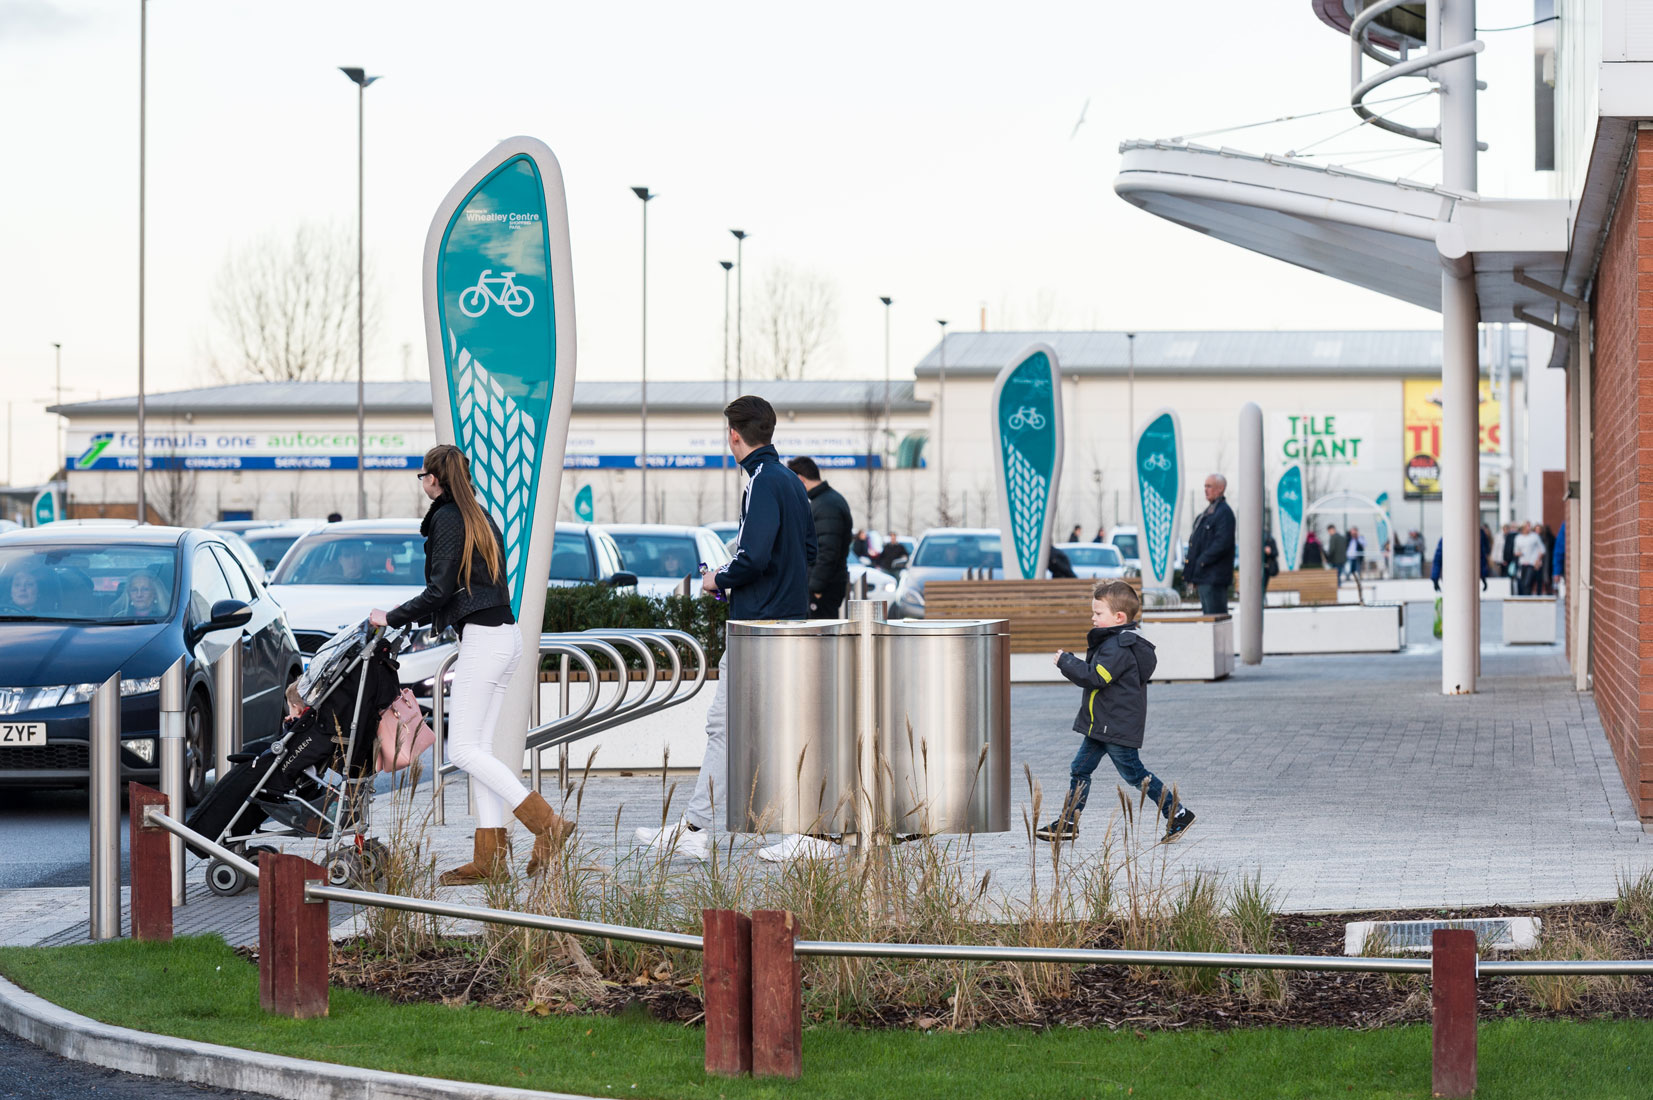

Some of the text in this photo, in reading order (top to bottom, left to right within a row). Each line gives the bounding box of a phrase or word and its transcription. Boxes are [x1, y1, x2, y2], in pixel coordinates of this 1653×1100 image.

[466, 212, 539, 222] Wheatley Centre
[120, 432, 404, 448] formula one autocenres
[118, 458, 153, 468] TYRS
[275, 457, 331, 467] SERVICING
[363, 457, 408, 467] BRAKES
[667, 457, 675, 466] 7
[675, 457, 705, 467] DAYS
[3, 726, 37, 741] ZYF
[282, 736, 312, 773] MACLAREN
